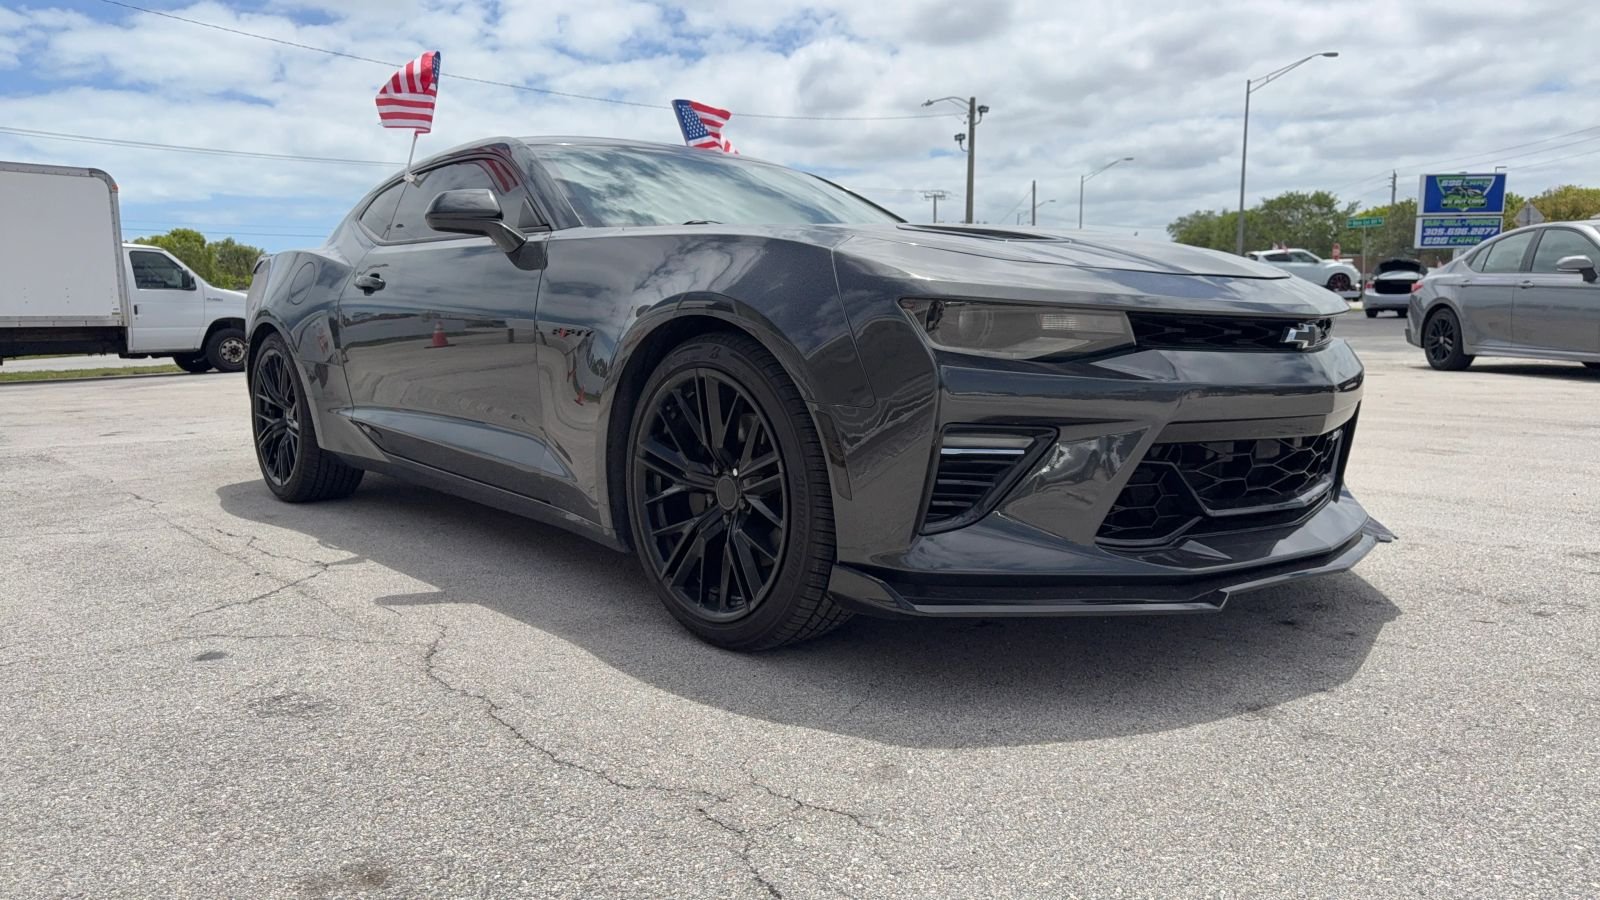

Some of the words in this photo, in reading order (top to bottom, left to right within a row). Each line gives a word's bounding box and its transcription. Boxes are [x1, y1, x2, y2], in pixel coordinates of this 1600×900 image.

[1424, 227, 1499, 236] 305.696.2277
[1423, 236, 1449, 245] 696
[1449, 236, 1482, 244] CARS
